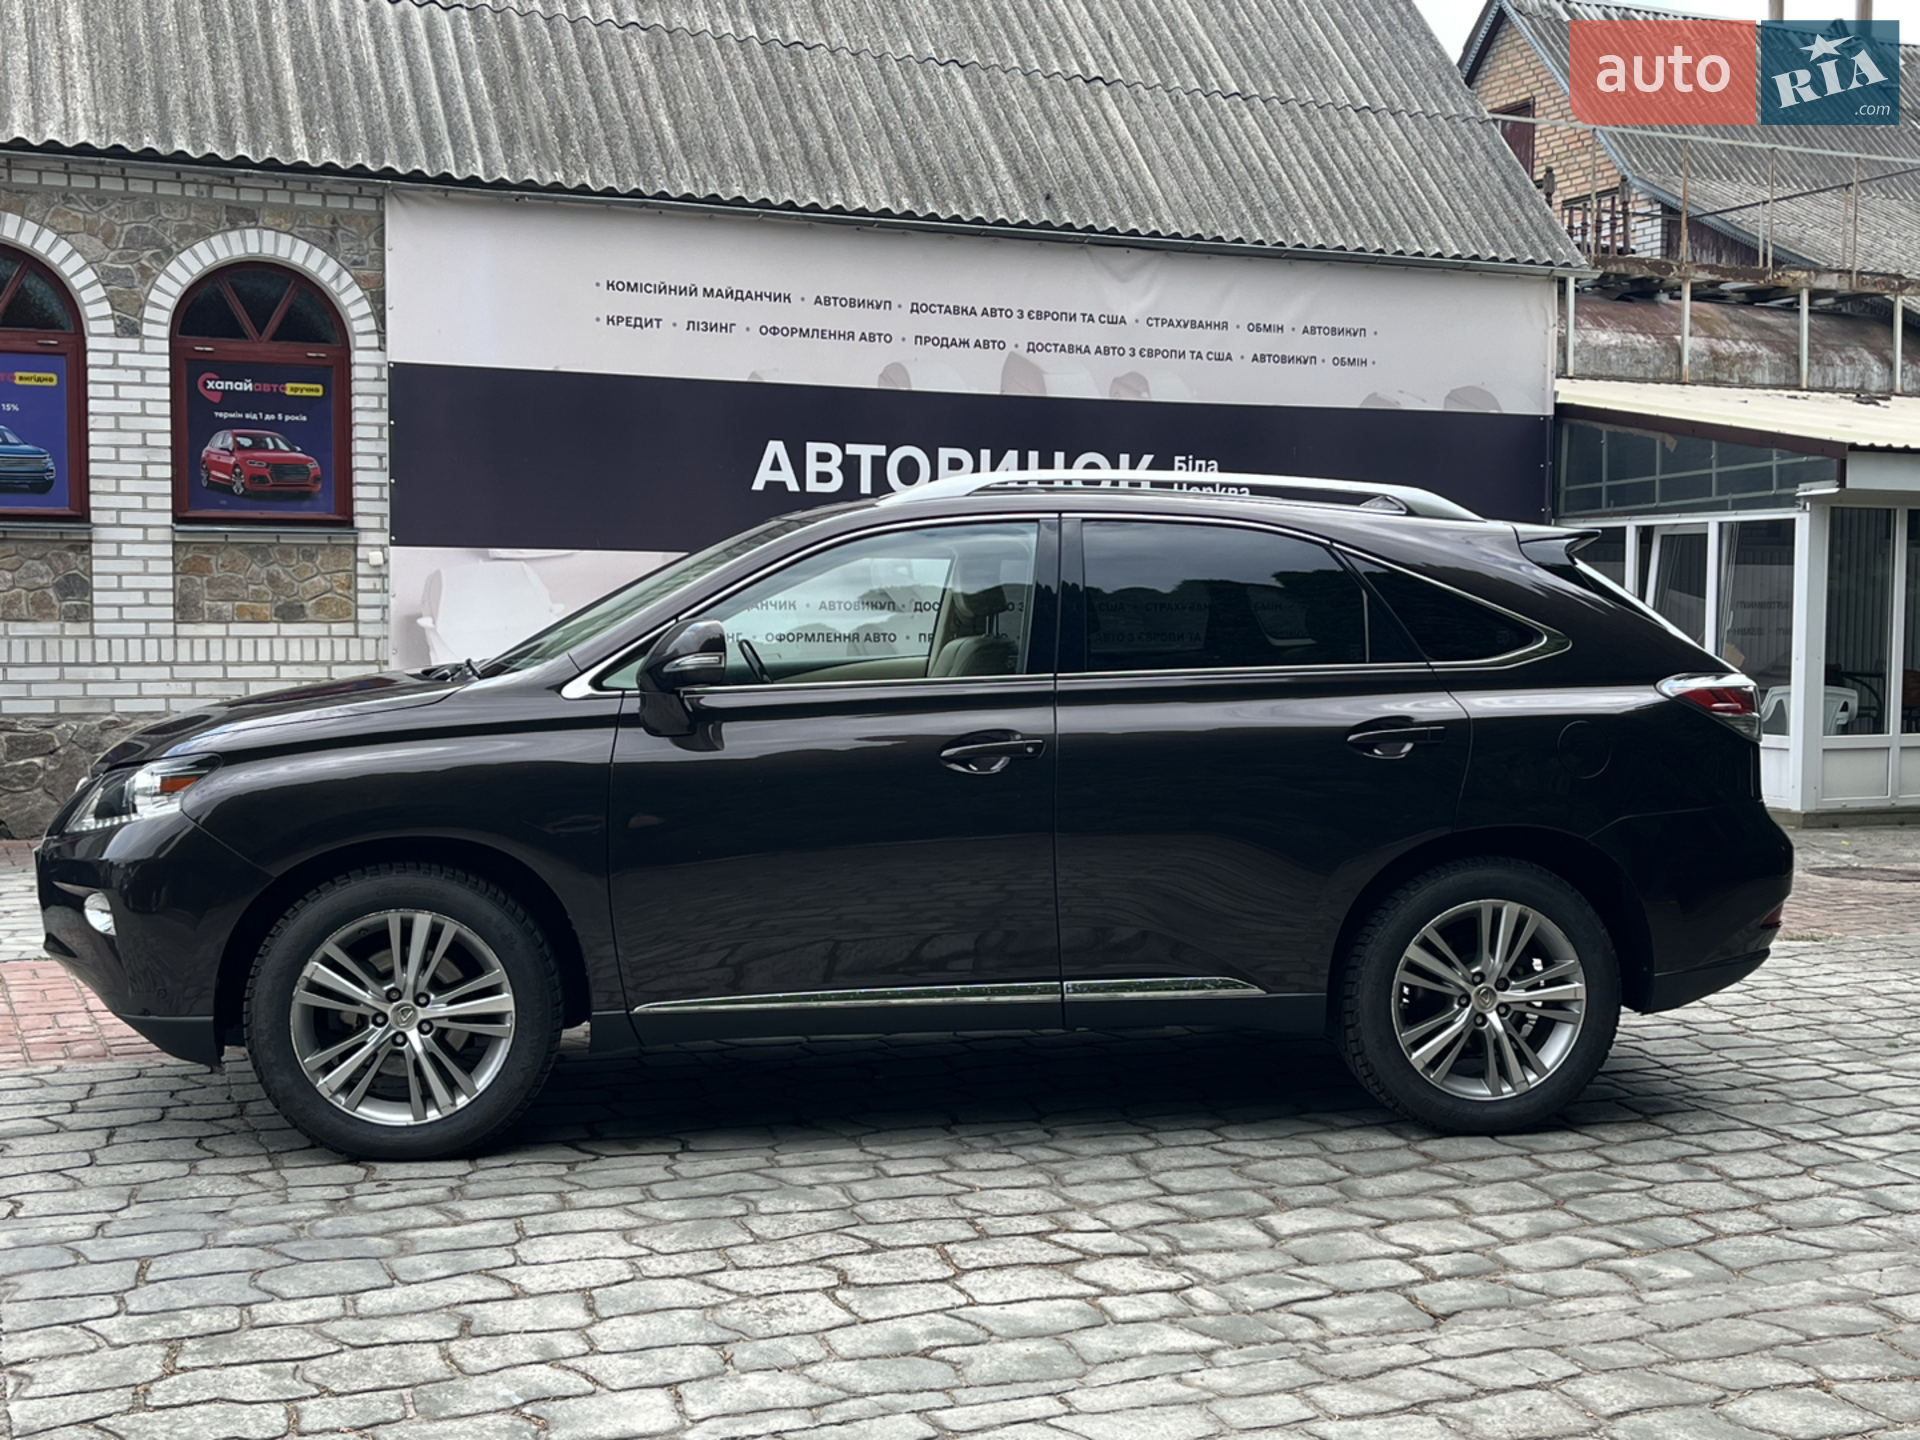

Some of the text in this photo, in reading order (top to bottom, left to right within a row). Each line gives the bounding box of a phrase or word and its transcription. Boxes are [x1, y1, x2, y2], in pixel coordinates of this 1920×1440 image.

[606, 280, 1367, 338] КОМІСІЙНИЙ МАЙДАНЧИК АВТОВИКУП ДОСТАВКА АВТО З ЄВРОПИ ТА США СТРАХУВАННЯ ОБМІН АВТОВИКУП
[606, 315, 1368, 367] КРЕДИТ ЛІЗИНГ ОФОРМЛЕННЯ АВТО ПРОДАЖ АВТО ДОСТАВКА АВТО З ЄВРОПИ ТА США АВТОВИКУП ОБМІН
[214, 411, 243, 420] термін
[264, 413, 276, 421] до
[284, 413, 308, 422] років
[1174, 454, 1220, 474] Біла
[750, 600, 896, 612] АНЧИК АВТОВИКУП
[765, 632, 897, 644] ОФОРМЛЕННЯ АВТО
